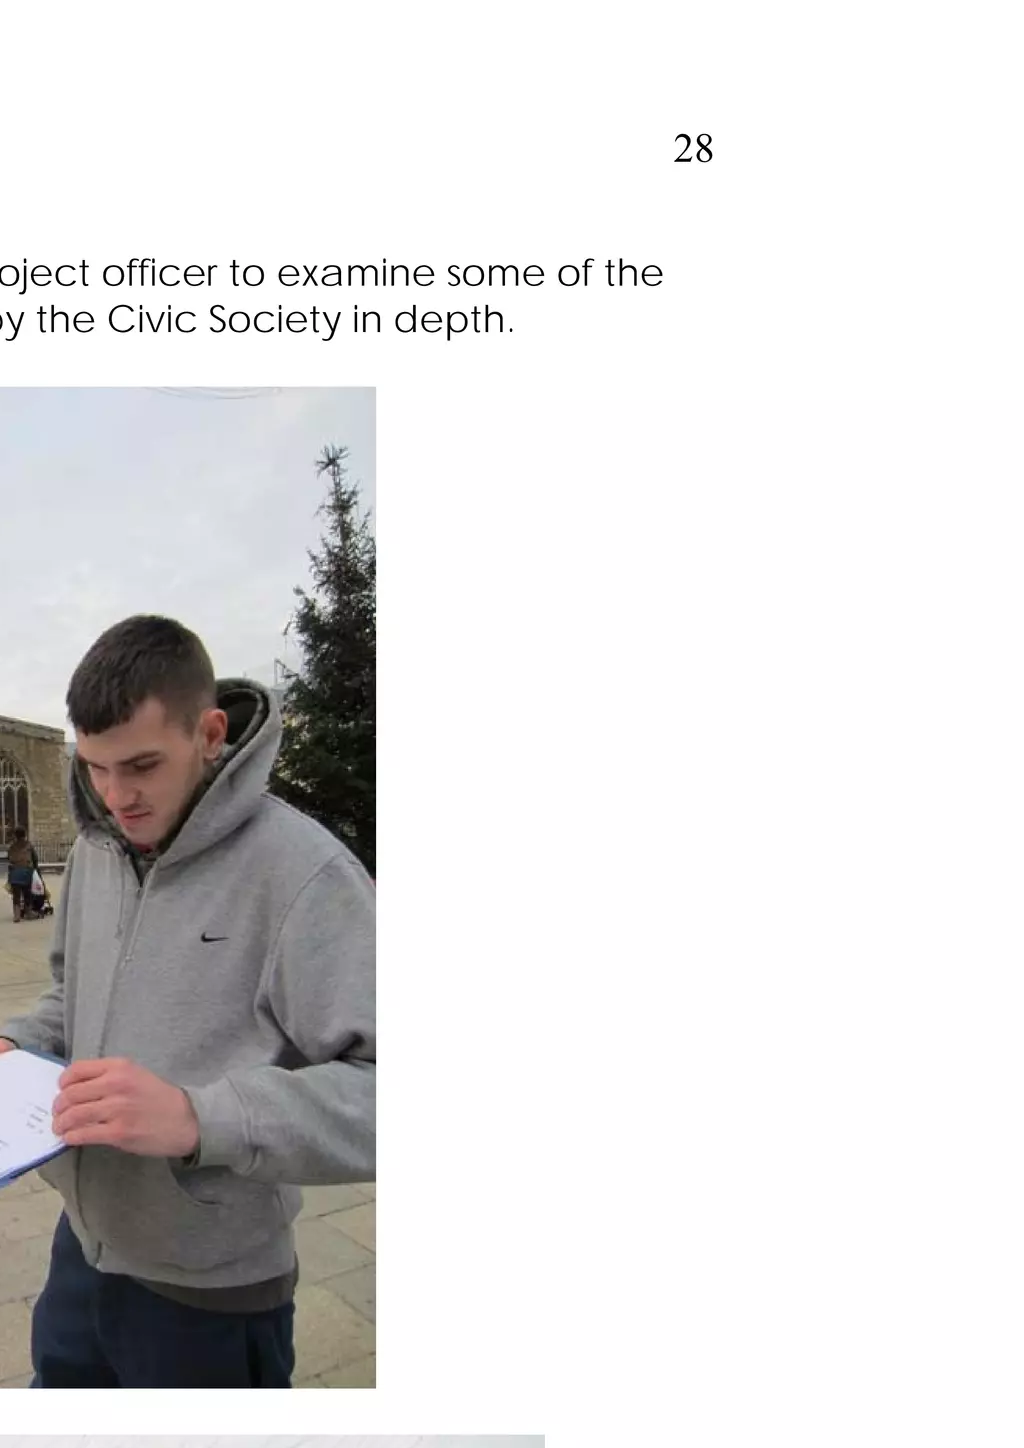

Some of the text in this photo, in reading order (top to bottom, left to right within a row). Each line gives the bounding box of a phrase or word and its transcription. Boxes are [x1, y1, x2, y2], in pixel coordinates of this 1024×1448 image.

[673, 134, 713, 163] 28
[103, 258, 217, 286] officer
[230, 260, 264, 286] to
[278, 258, 434, 286] examine
[448, 265, 544, 286] some
[558, 258, 594, 286] of
[605, 258, 663, 286] the
[37, 305, 94, 333] the
[109, 305, 196, 333] Civic
[210, 305, 341, 341] Society
[354, 305, 380, 332] in
[395, 305, 512, 341] depth.
